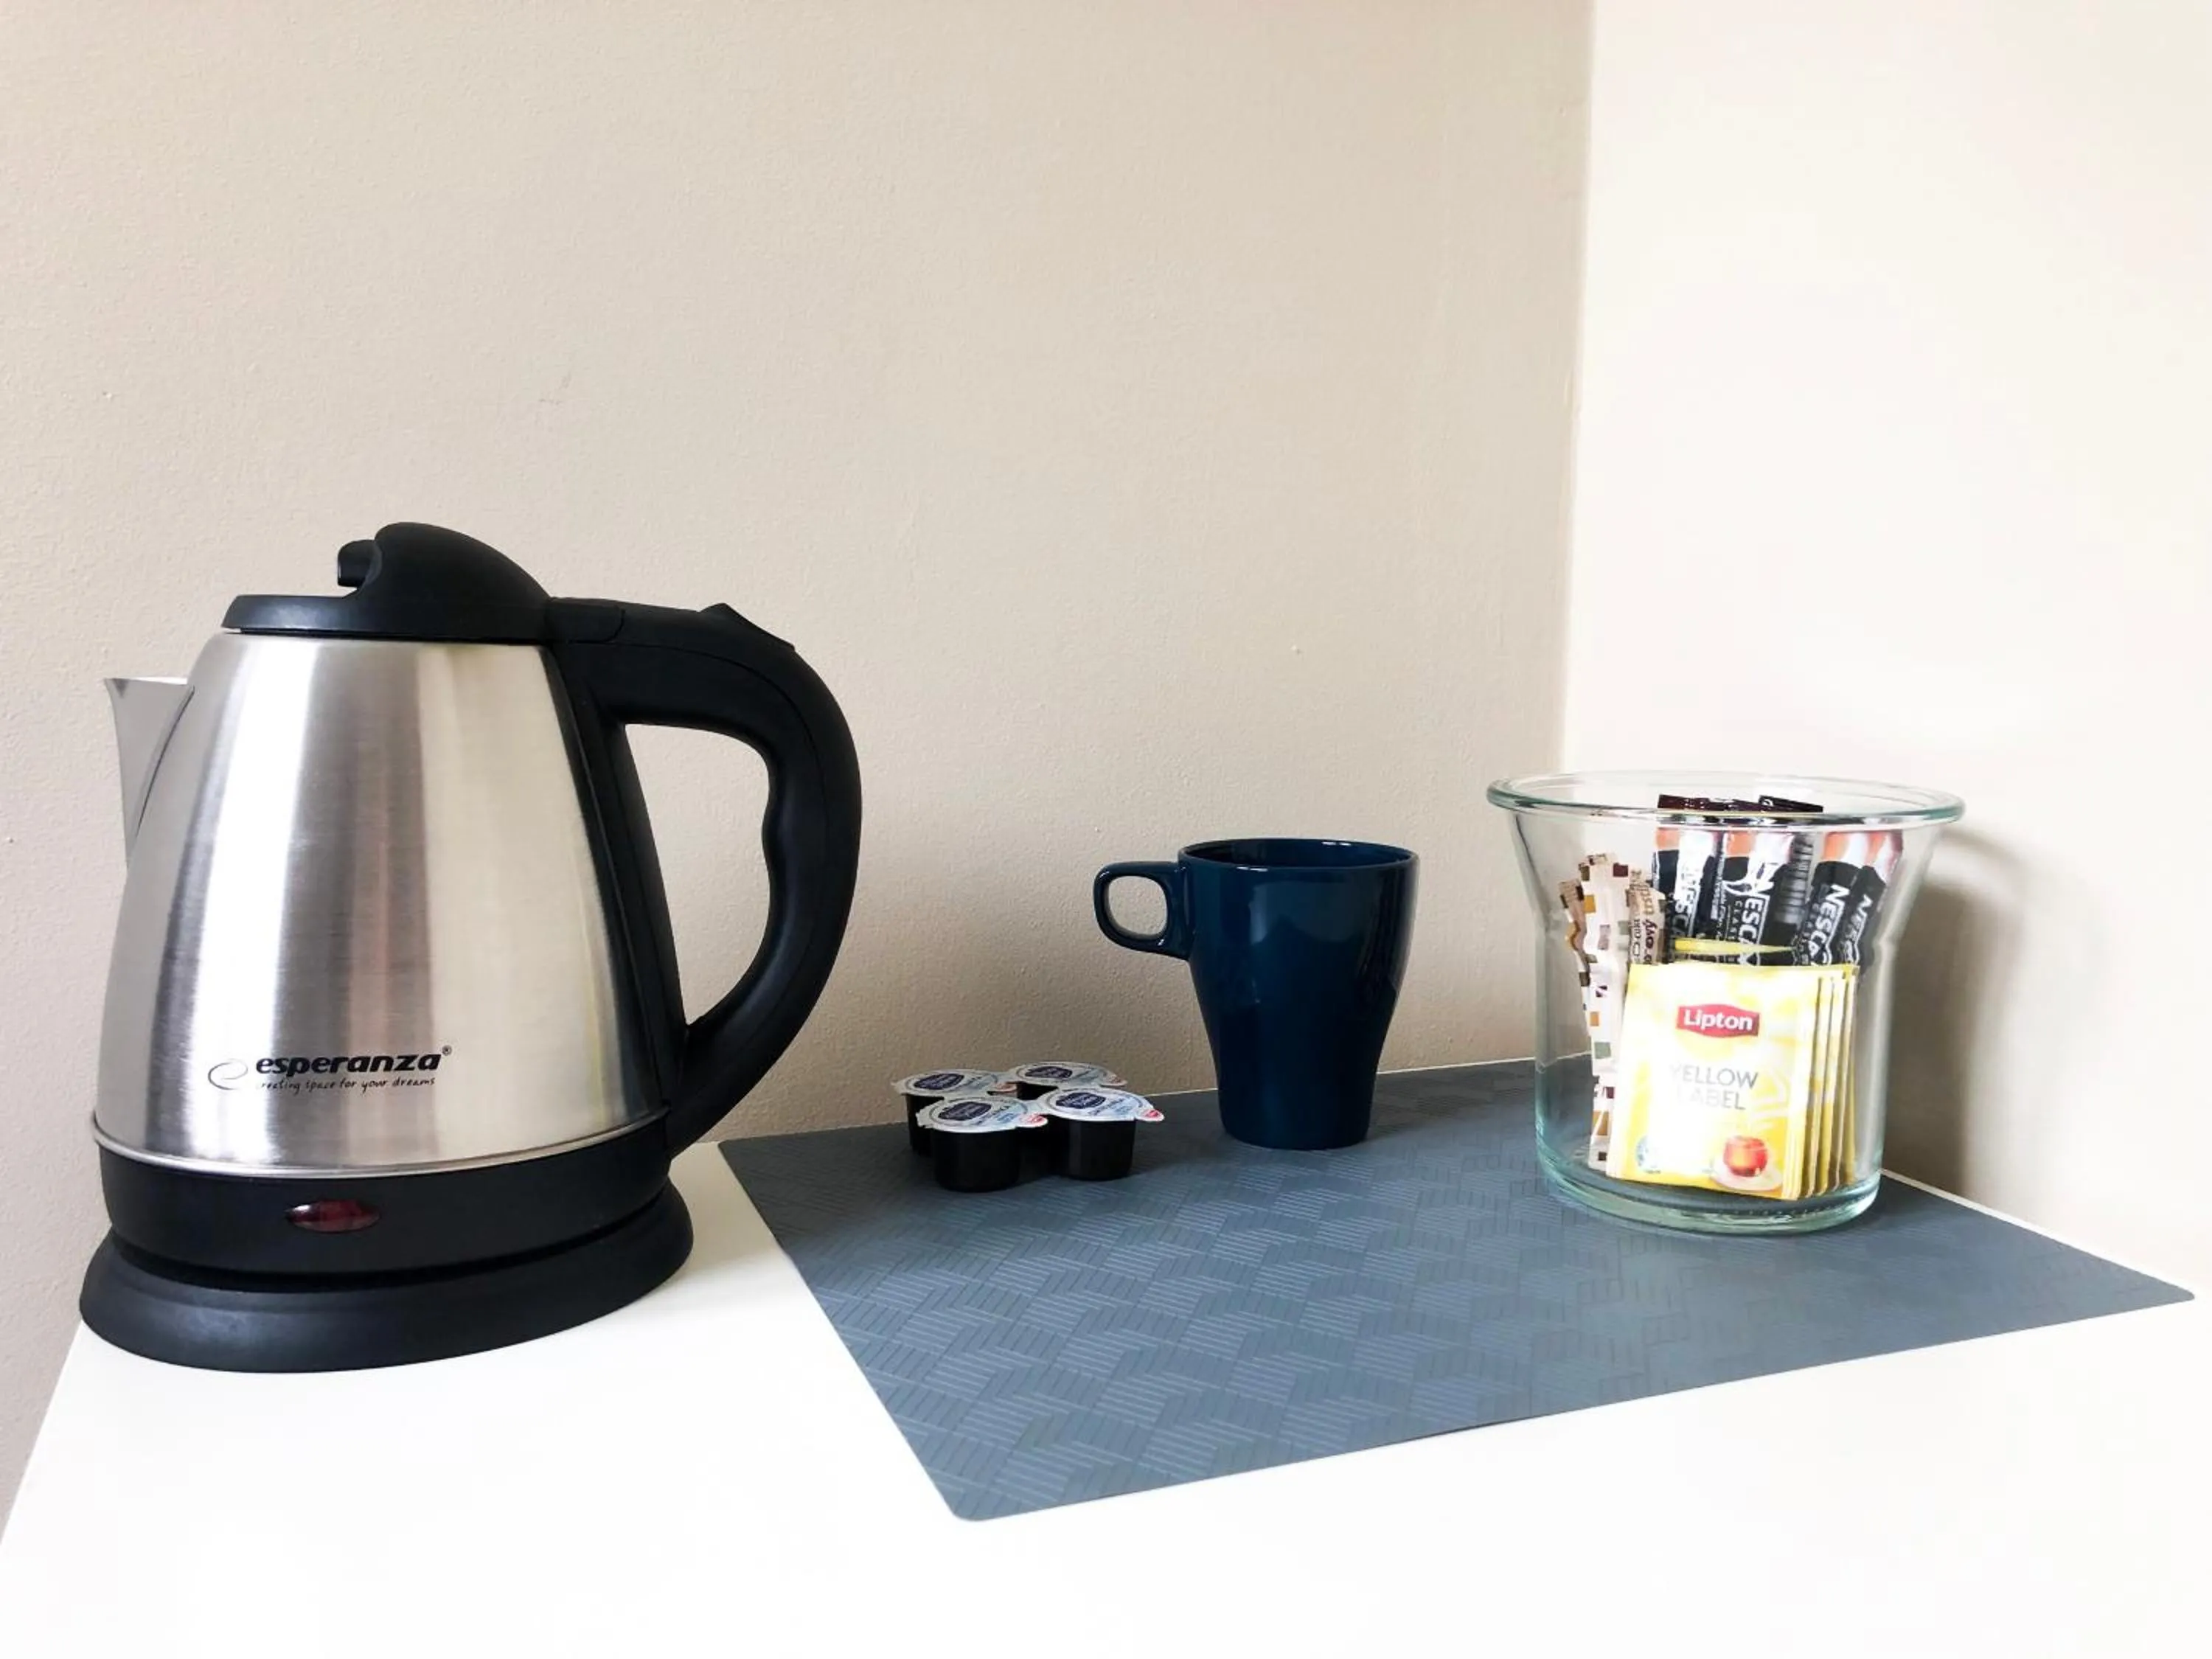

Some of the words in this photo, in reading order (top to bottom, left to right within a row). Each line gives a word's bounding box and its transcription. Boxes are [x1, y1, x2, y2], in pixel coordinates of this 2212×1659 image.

[1683, 1009, 1753, 1031] Lipton
[256, 1054, 442, 1077] esperanza
[1669, 1062, 1759, 1090] YELLOW
[255, 1077, 301, 1096] reating
[339, 1077, 358, 1088] for
[361, 1079, 389, 1093] your
[392, 1077, 436, 1087] dreams
[1677, 1085, 1747, 1110] LABEL
